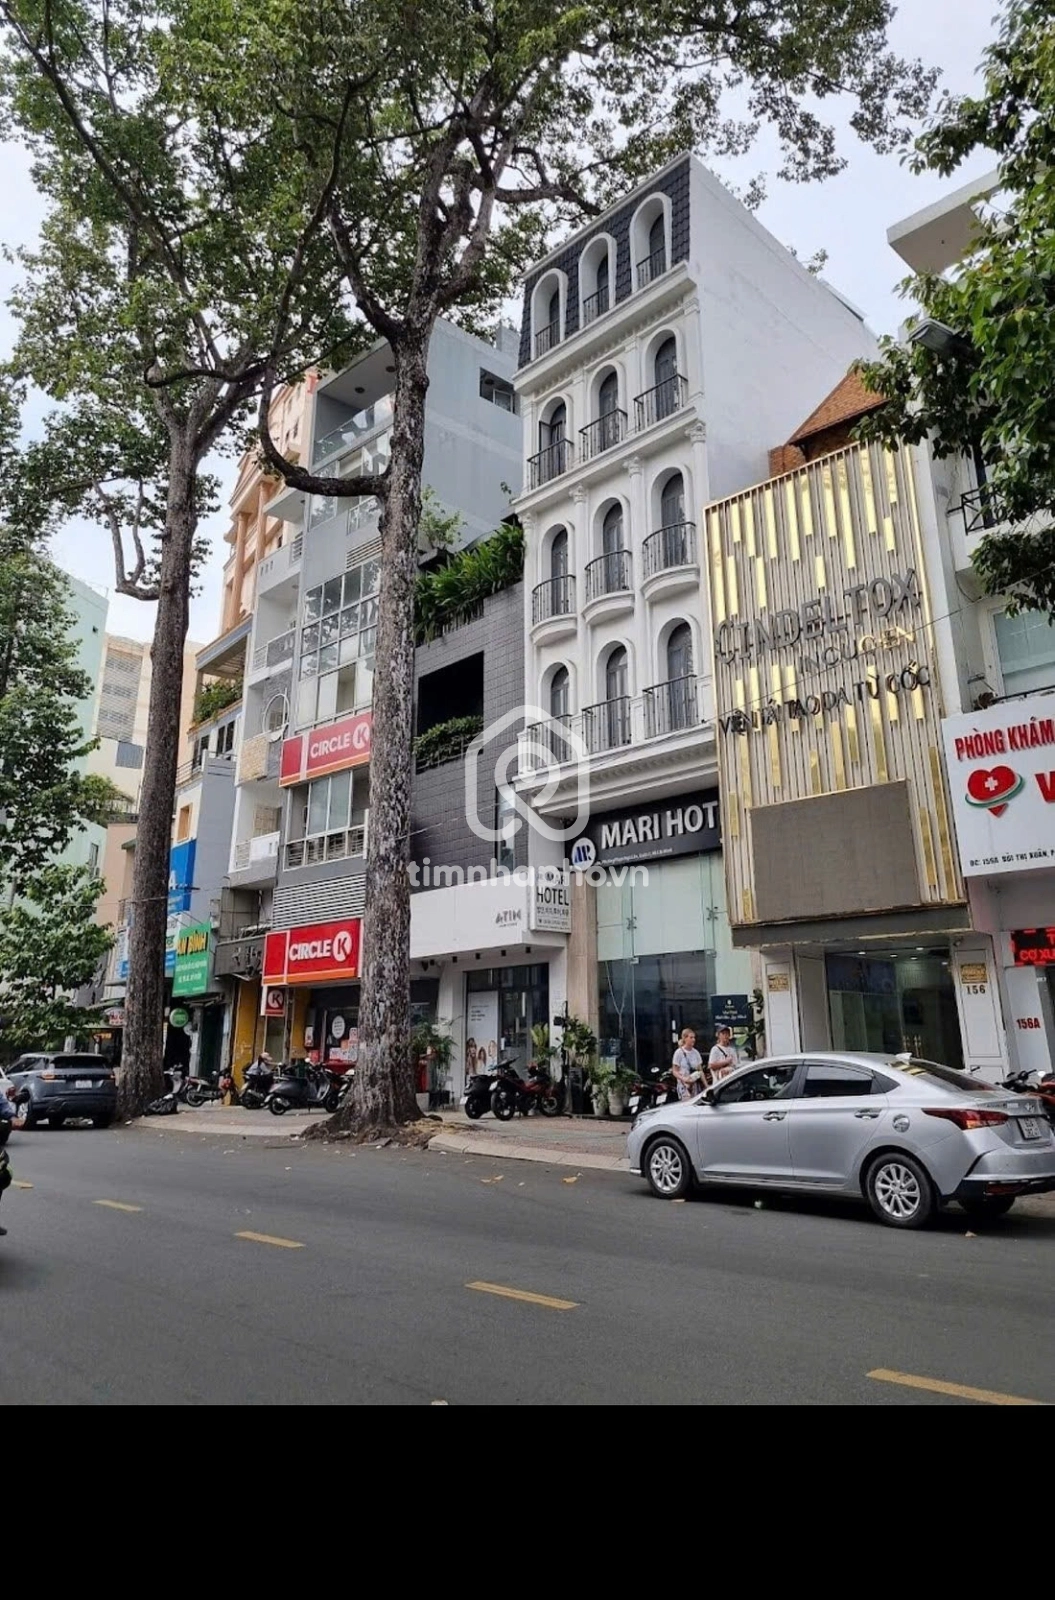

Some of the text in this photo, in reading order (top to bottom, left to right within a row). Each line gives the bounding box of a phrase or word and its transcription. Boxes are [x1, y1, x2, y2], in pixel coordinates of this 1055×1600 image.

[822, 687, 853, 712] DA
[310, 721, 371, 758] CIRCLE K
[954, 727, 1007, 762] PHÒNG
[601, 800, 718, 850] MARI HOT
[536, 887, 570, 907] HOTEL
[289, 939, 332, 961] CIRCLE
[332, 931, 352, 962] K
[966, 984, 986, 995] 156
[1016, 1017, 1041, 1030] 156A
